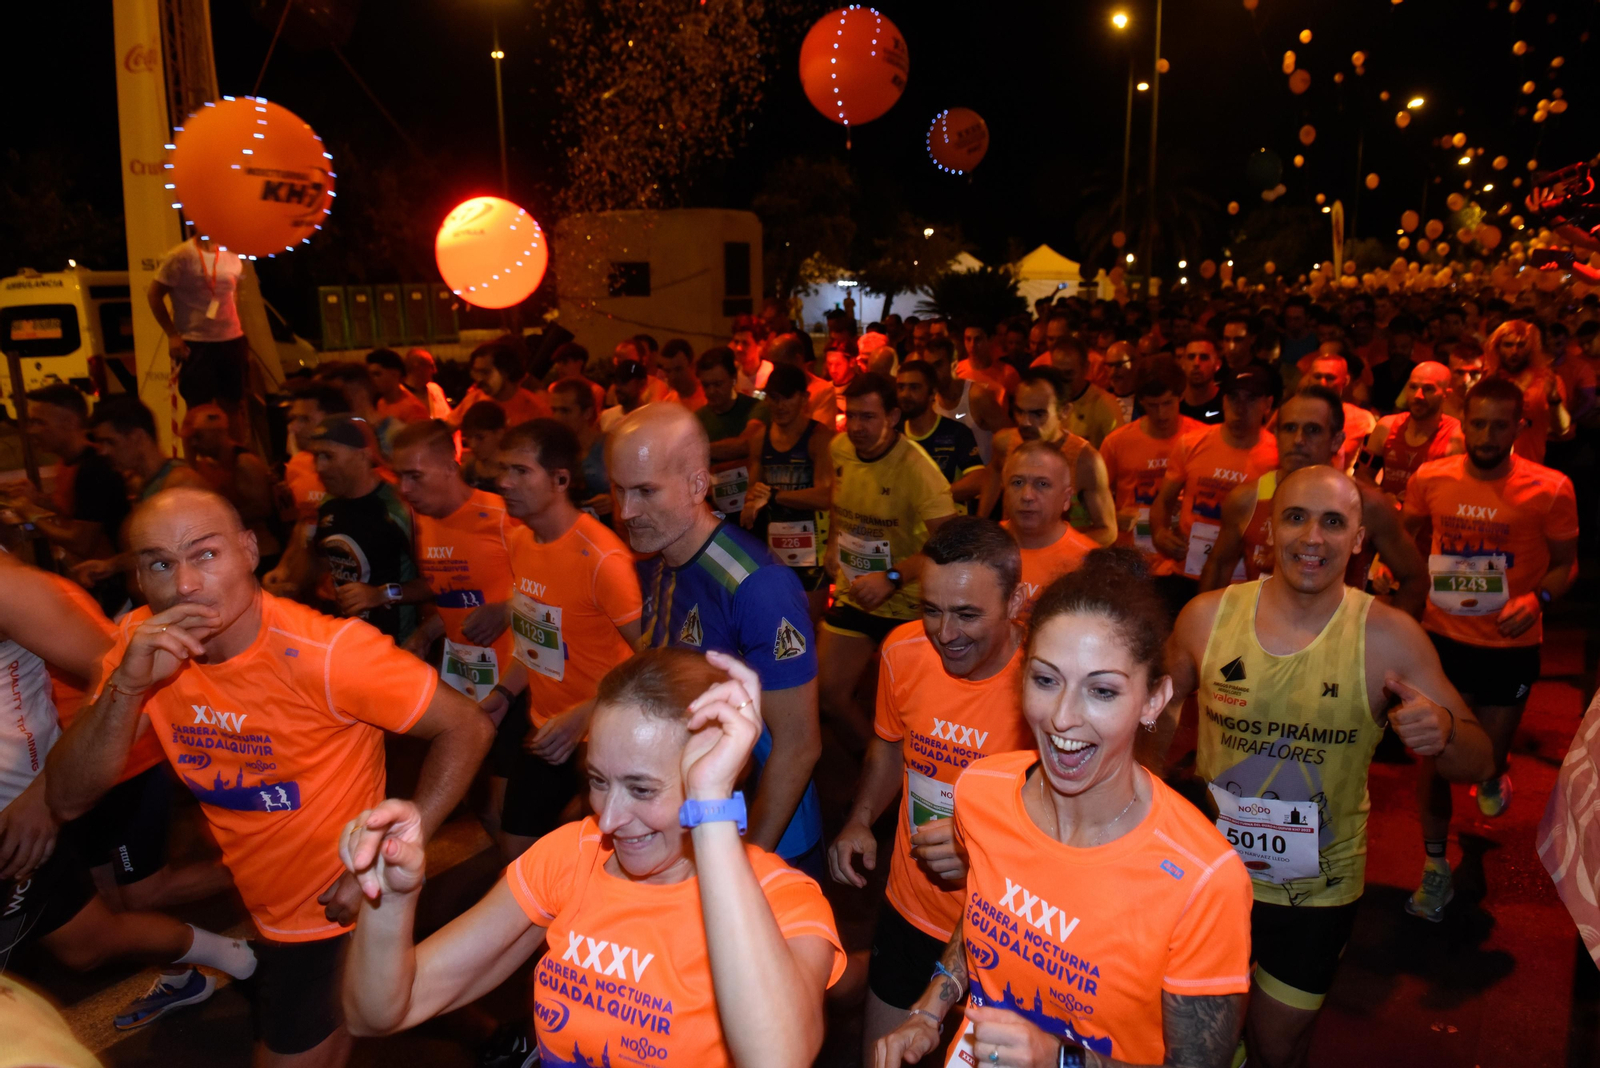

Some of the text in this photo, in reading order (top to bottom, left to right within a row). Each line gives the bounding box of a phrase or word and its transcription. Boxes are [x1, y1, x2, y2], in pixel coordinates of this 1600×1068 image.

[1213, 468, 1248, 483] XXXV
[1456, 503, 1498, 520] XXXV
[427, 546, 454, 559] XXXV
[781, 538, 801, 548] 226
[850, 555, 871, 570] 569
[520, 577, 547, 599] XXXV
[520, 619, 545, 645] 1129
[457, 661, 480, 683] 110
[8, 660, 21, 711] QUALITY
[1212, 691, 1248, 707] valora
[191, 704, 248, 733] XXXV
[1206, 706, 1359, 745] AMIGOS PIRÁMIDE
[171, 722, 273, 744] CARRERA NOCTURNA
[179, 734, 274, 757] GUADALQUIVIR
[910, 730, 949, 752] CARRERA
[930, 717, 989, 750] XXXV
[1220, 732, 1327, 765] MIRAFLORES
[1226, 827, 1287, 854] 5010
[119, 845, 134, 872] Joma
[1245, 851, 1271, 861] NARVAEZ
[1272, 855, 1290, 863] LLEDO
[998, 877, 1081, 943] XXXV
[971, 892, 1101, 979] CARRERA NOCTURNA
[561, 930, 655, 983] XXXV
[971, 911, 1098, 996] GUADALQUIVIR
[539, 971, 671, 1036] GUADALQUIVIR
[595, 978, 674, 1015] NOCTURNA
[971, 993, 983, 1007] 23
